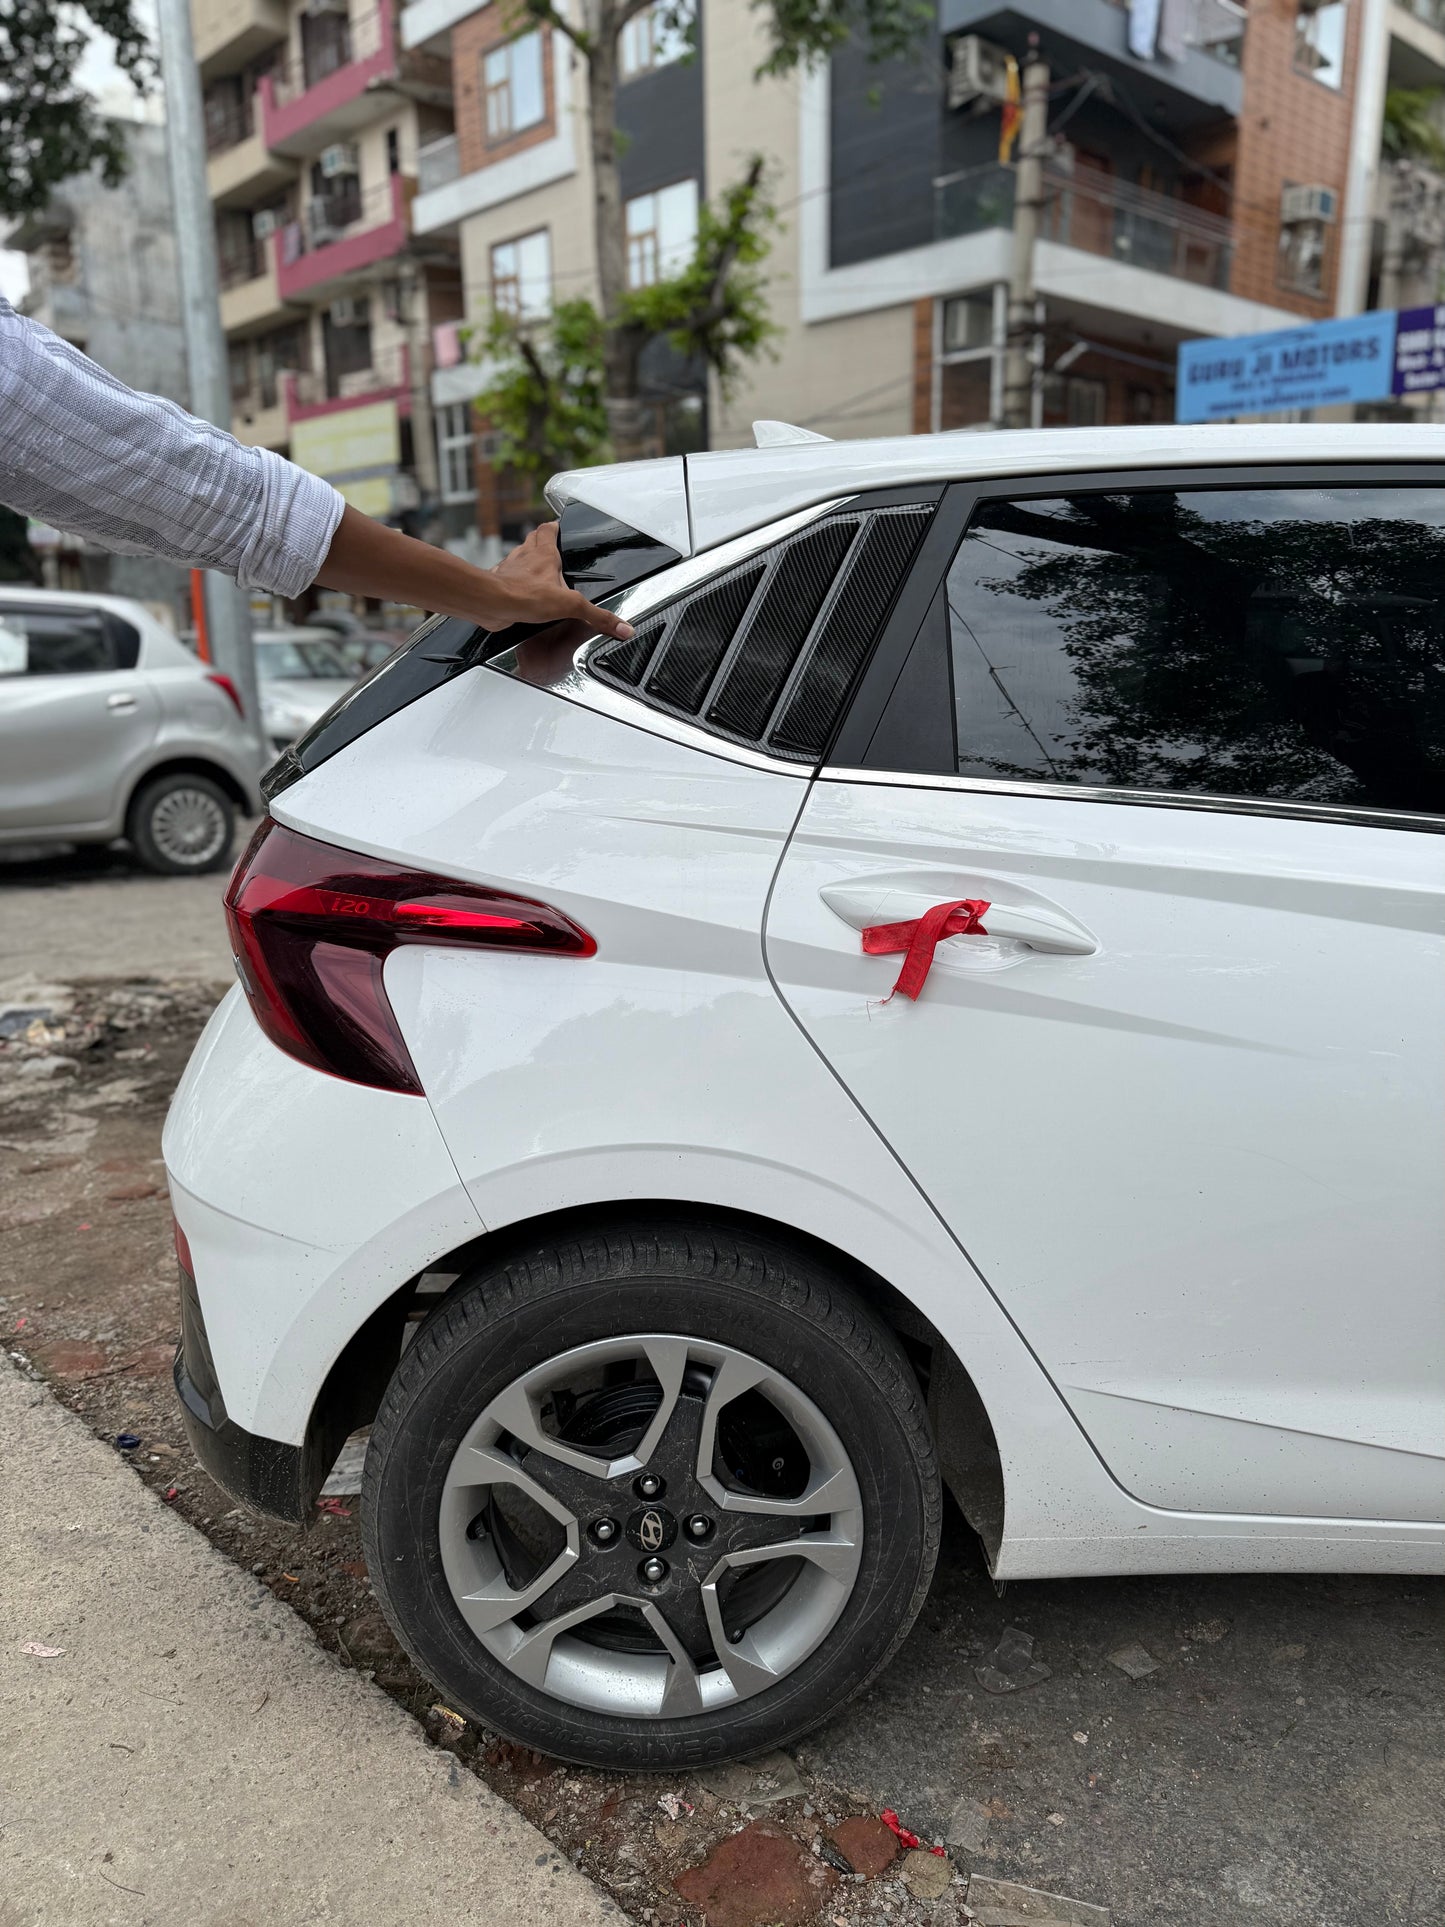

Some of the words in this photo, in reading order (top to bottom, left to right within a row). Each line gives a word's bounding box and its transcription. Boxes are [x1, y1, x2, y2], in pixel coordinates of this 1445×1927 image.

[1188, 358, 1245, 385] GURU
[1280, 336, 1379, 369] MOTORS
[640, 1735, 727, 1762] CEAT
